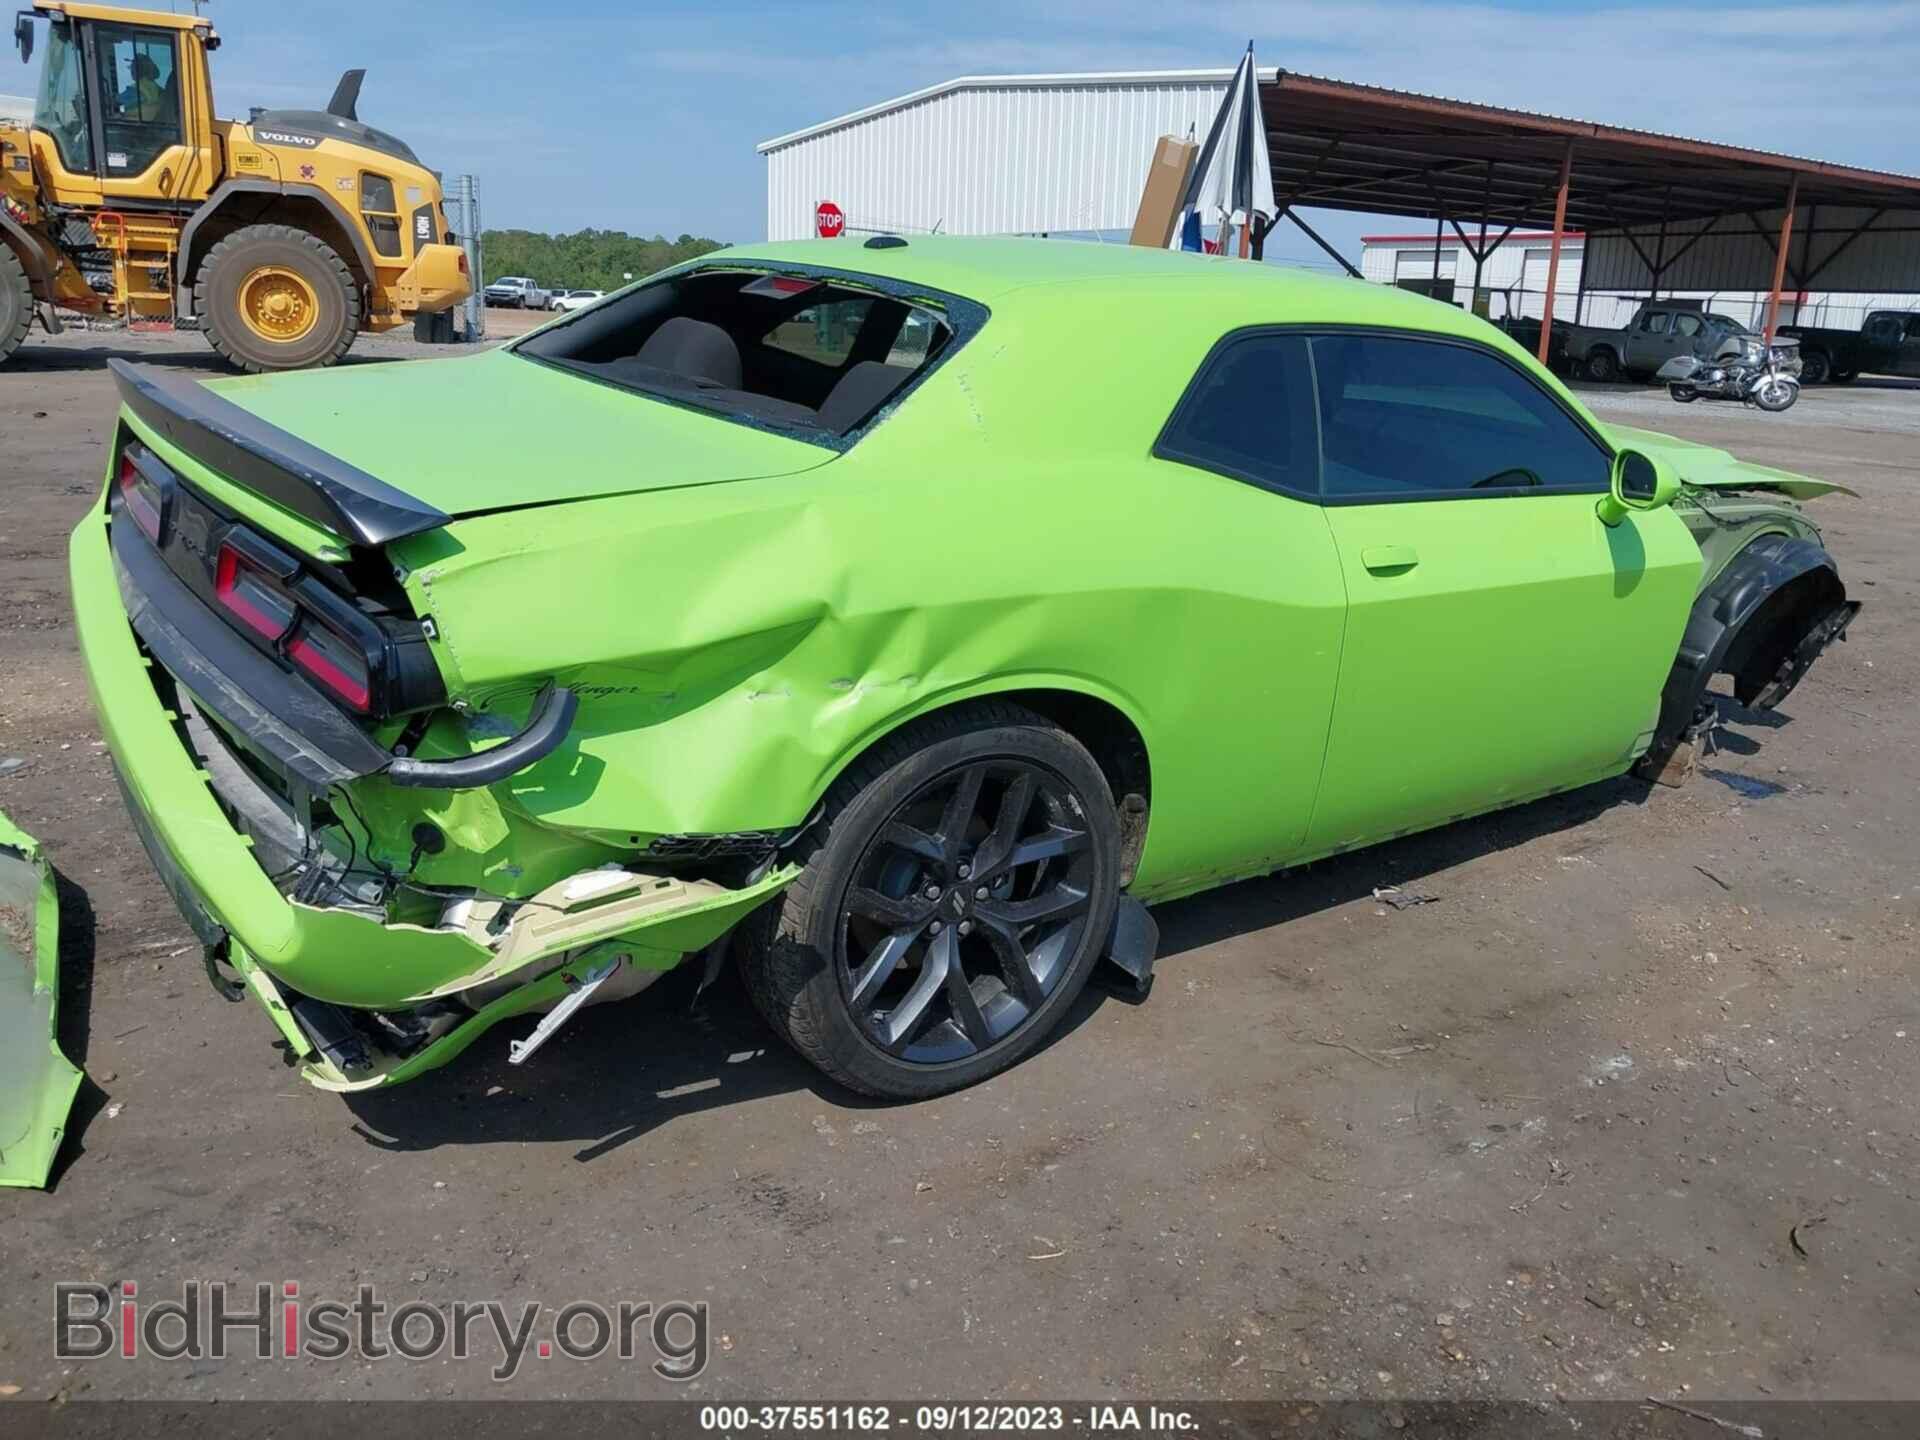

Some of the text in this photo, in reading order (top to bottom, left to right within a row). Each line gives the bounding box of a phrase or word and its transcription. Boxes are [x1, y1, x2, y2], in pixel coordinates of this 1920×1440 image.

[259, 131, 316, 146] VOLVO
[416, 215, 430, 239] L90H
[817, 213, 842, 228] STOP
